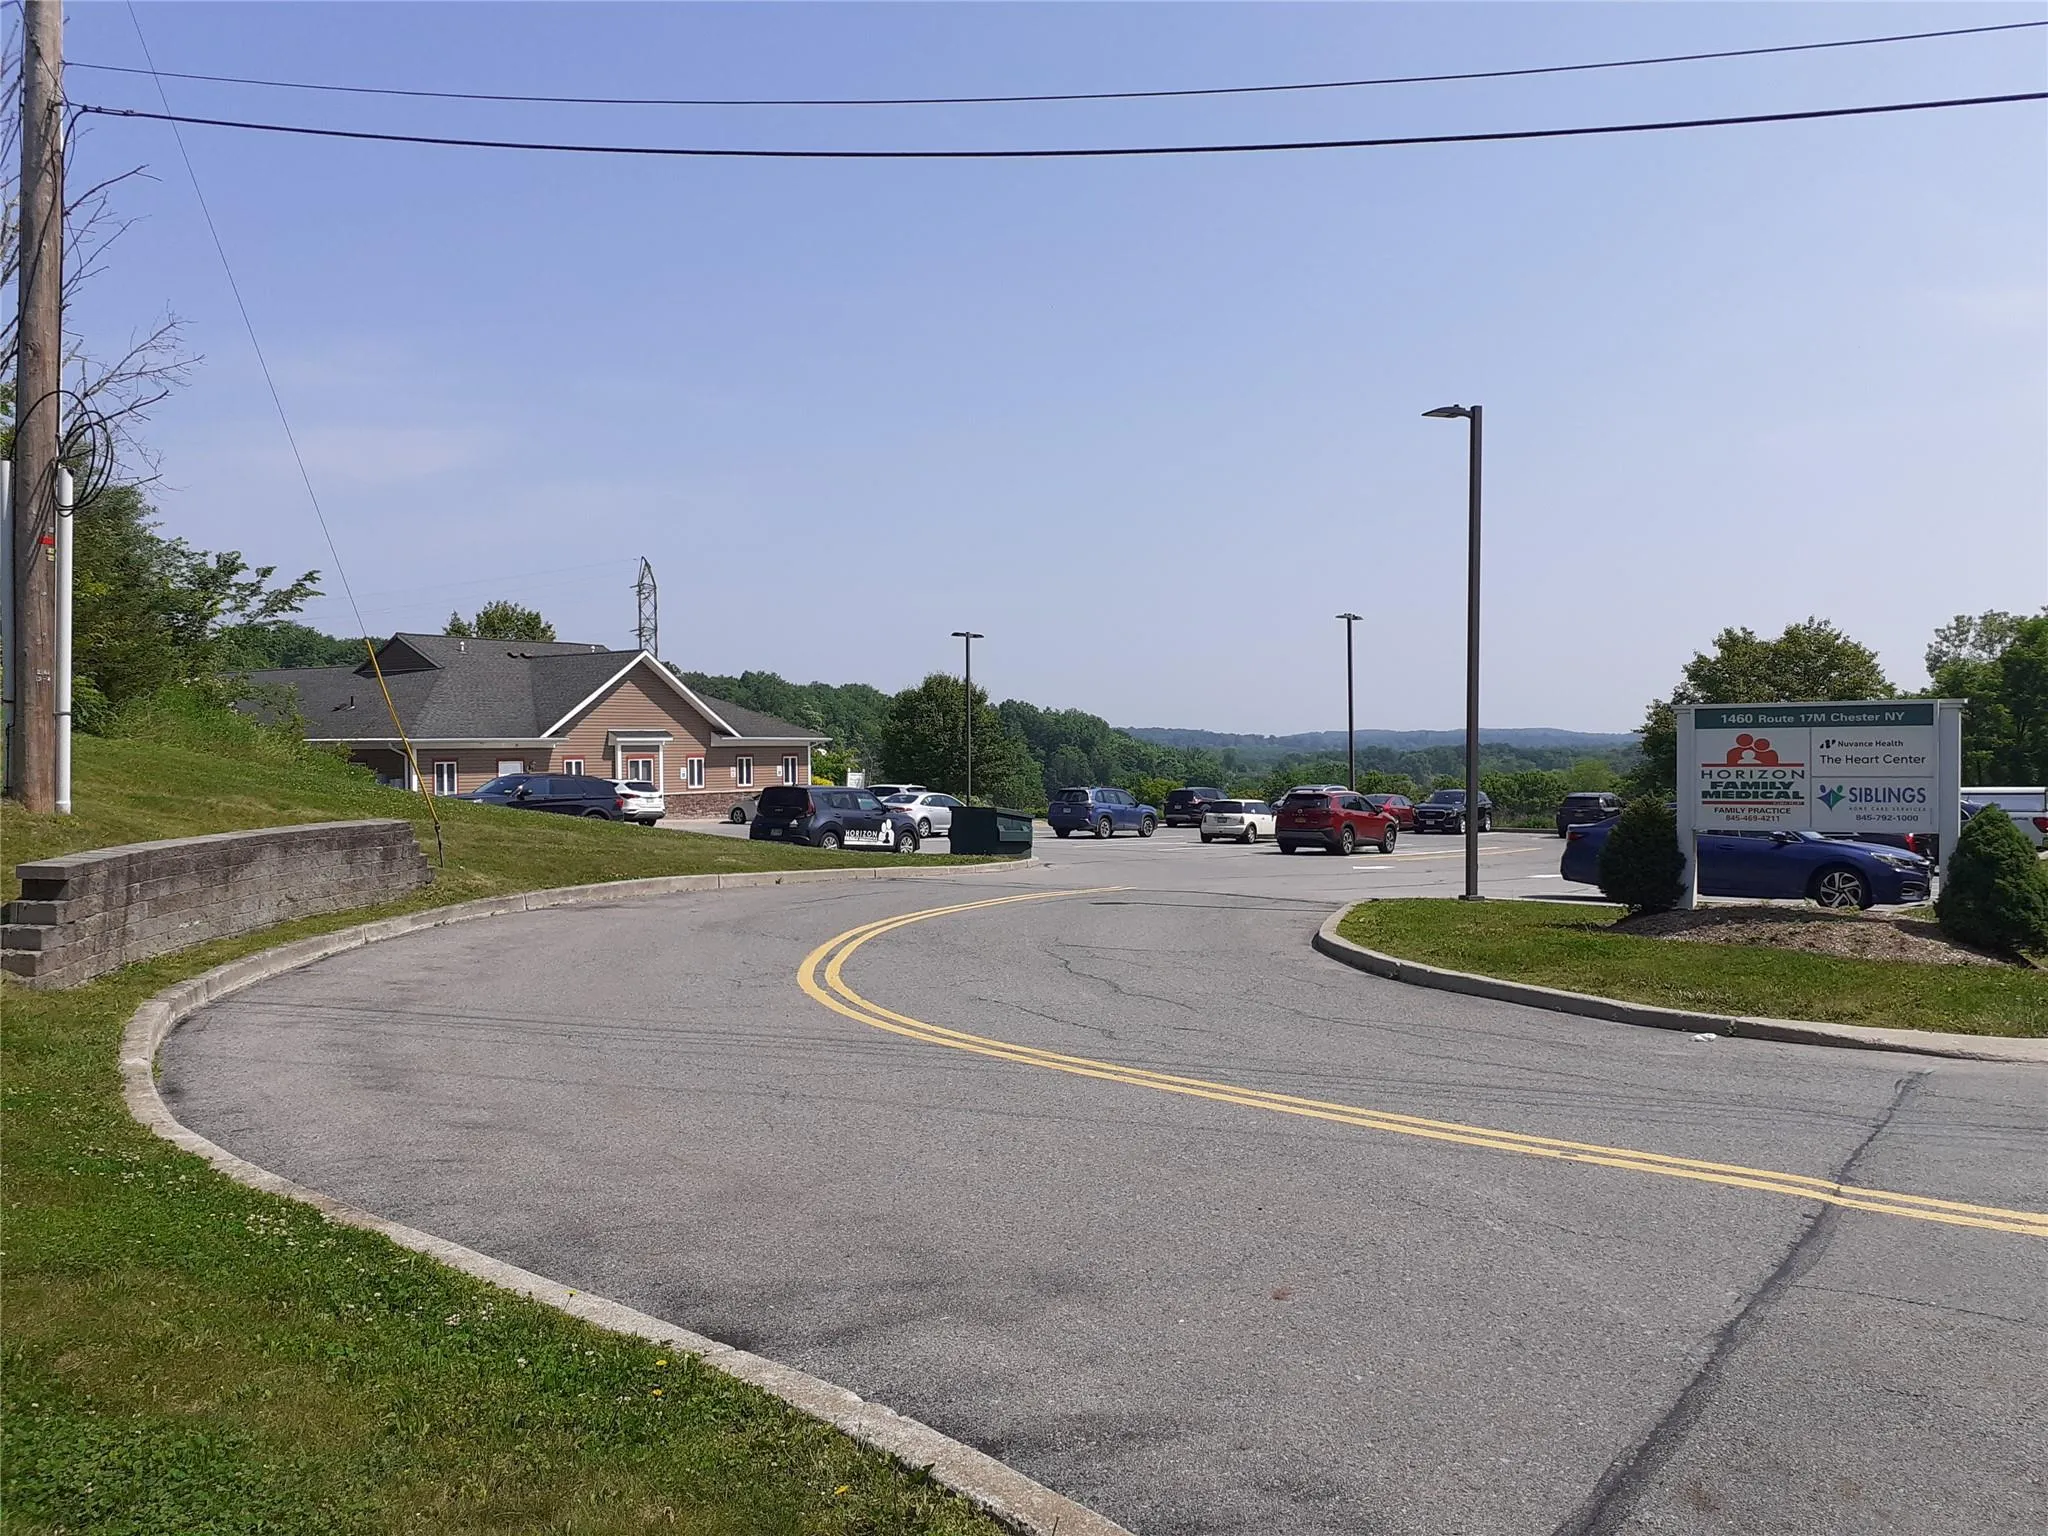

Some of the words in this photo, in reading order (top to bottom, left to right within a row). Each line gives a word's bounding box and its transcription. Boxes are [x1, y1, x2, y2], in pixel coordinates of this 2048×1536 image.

[1721, 713, 1753, 724] 1460
[1758, 714, 1795, 723] Route
[1800, 713, 1826, 722] 17M
[1830, 712, 1881, 722] Chester
[1885, 711, 1905, 721] NY
[1838, 740, 1874, 748] Nuvance
[1875, 739, 1904, 748] Health
[1820, 754, 1842, 765] The
[1845, 754, 1880, 765] Heart
[1883, 753, 1926, 765] Center
[1701, 769, 1805, 779] HORIZON
[1710, 781, 1794, 790] FAMILY
[1701, 790, 1805, 800] MEDICAL
[1848, 786, 1927, 803] SIBLINGS
[1748, 807, 1791, 815] PRACTICE
[1725, 814, 1780, 823] 845-469-4211
[1855, 814, 1919, 822] 845-792-1000
[845, 829, 878, 837] HORIZON
